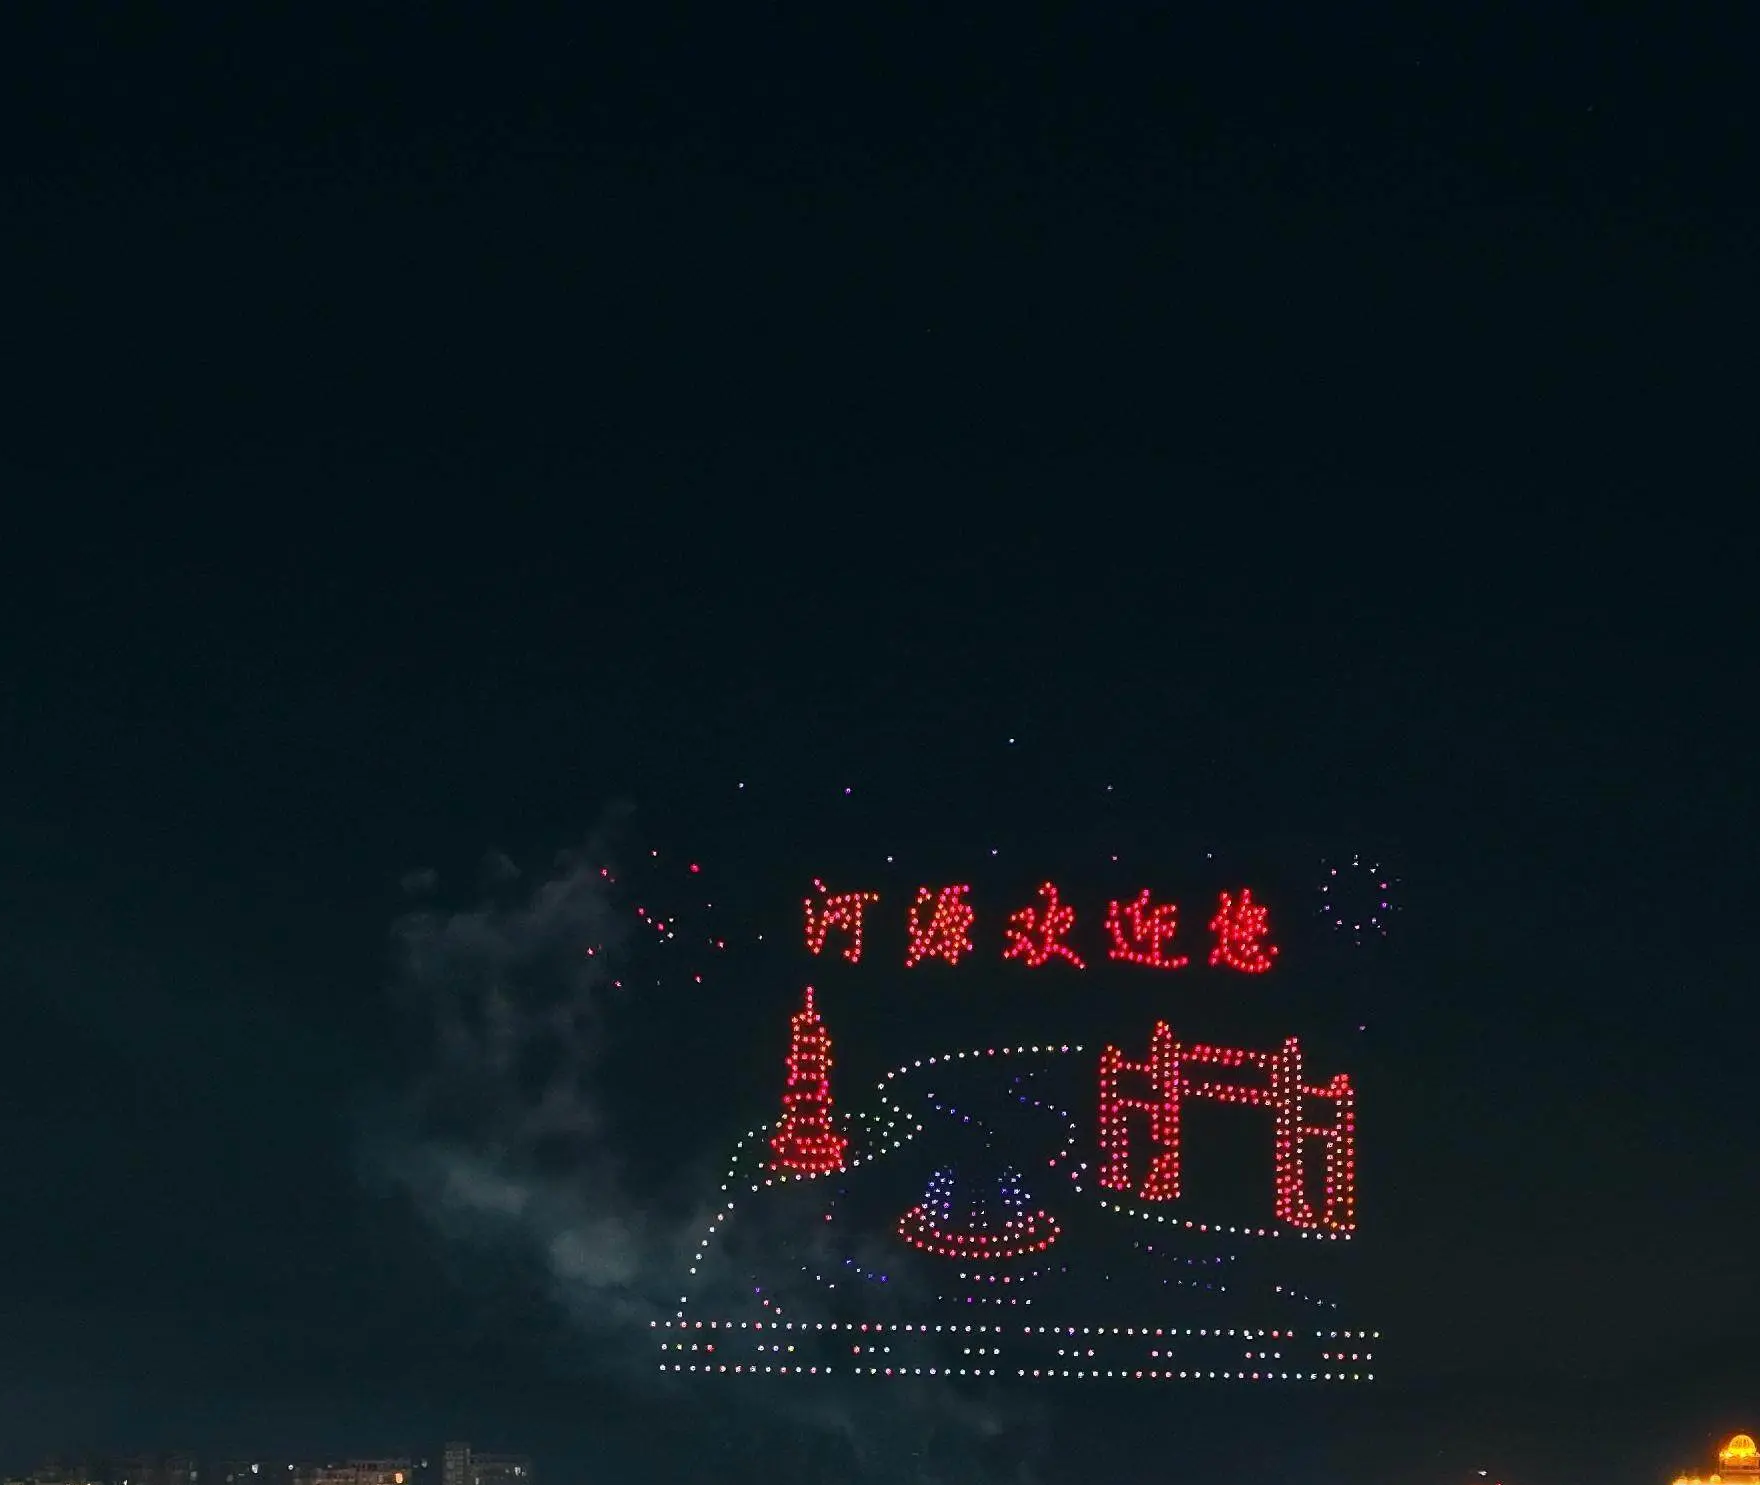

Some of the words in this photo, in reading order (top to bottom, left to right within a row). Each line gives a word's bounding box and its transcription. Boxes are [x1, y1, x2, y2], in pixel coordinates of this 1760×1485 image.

[803, 878, 1279, 974] 河源欢迎您
